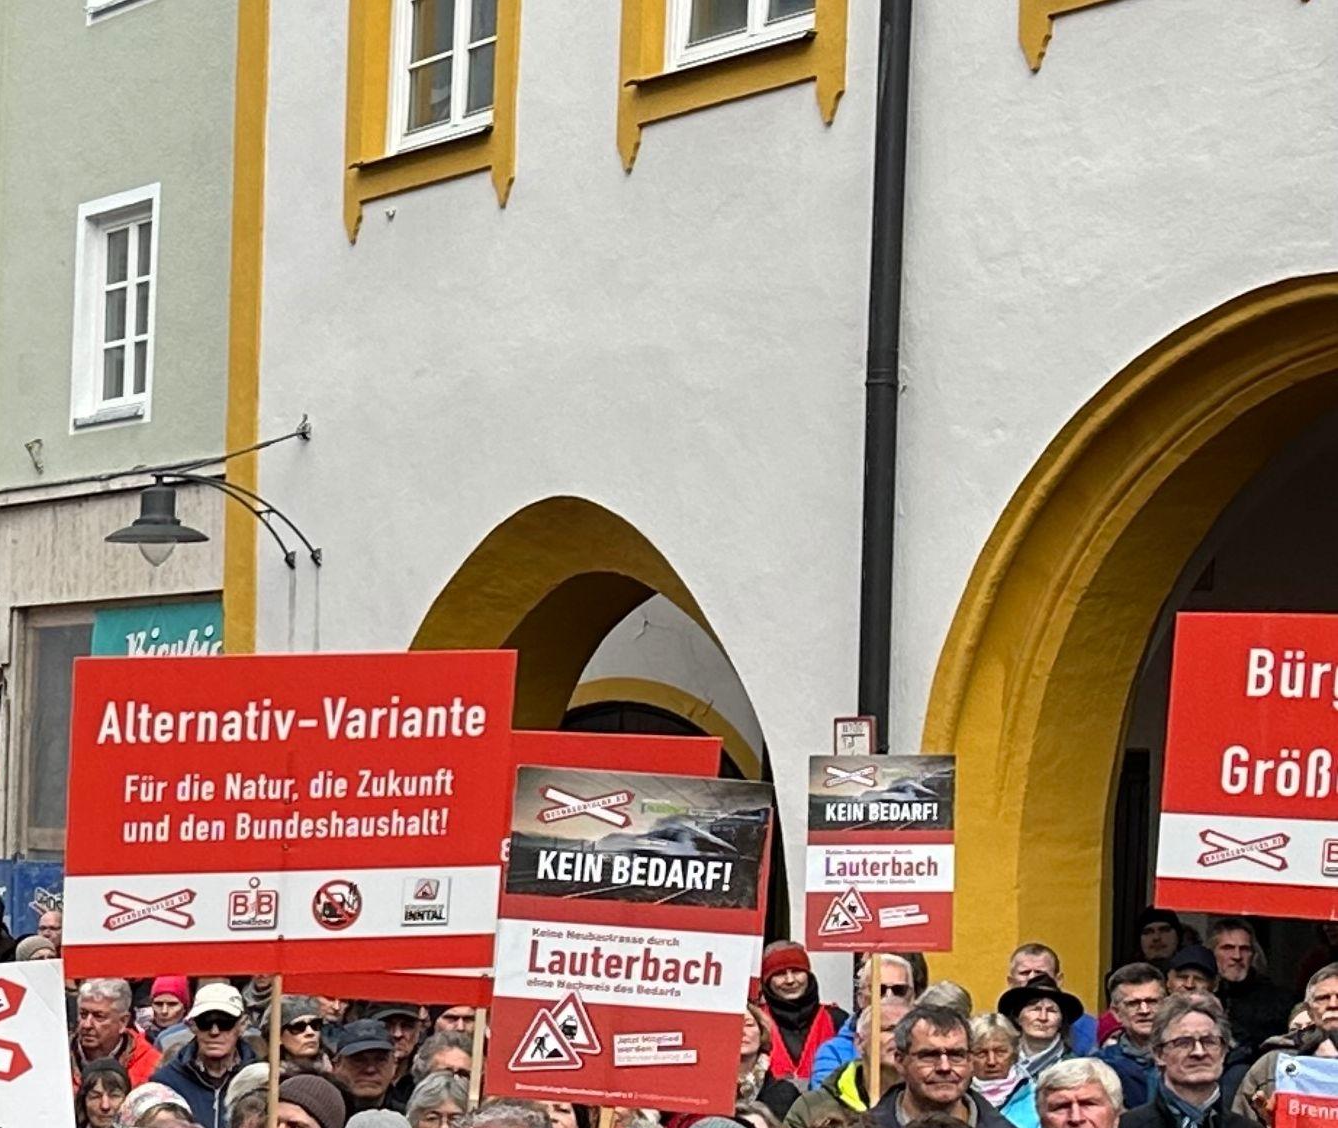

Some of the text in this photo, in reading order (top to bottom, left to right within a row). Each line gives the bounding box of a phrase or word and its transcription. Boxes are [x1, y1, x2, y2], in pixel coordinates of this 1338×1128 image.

[1246, 648, 1338, 710] Bür
[97, 696, 486, 745] Alternativ-Variante
[125, 769, 454, 803] Für die Natur, die Zukunft
[1221, 745, 1338, 798] Größ
[123, 807, 449, 842] und den Bundeshaushalt!
[825, 802, 938, 822] KEIN BEDARF!
[537, 850, 732, 892] KEIN BEDARF!
[825, 856, 938, 877] Lauterbach
[528, 940, 722, 987] Lauterbach
[1288, 1099, 1338, 1120] Brenn
